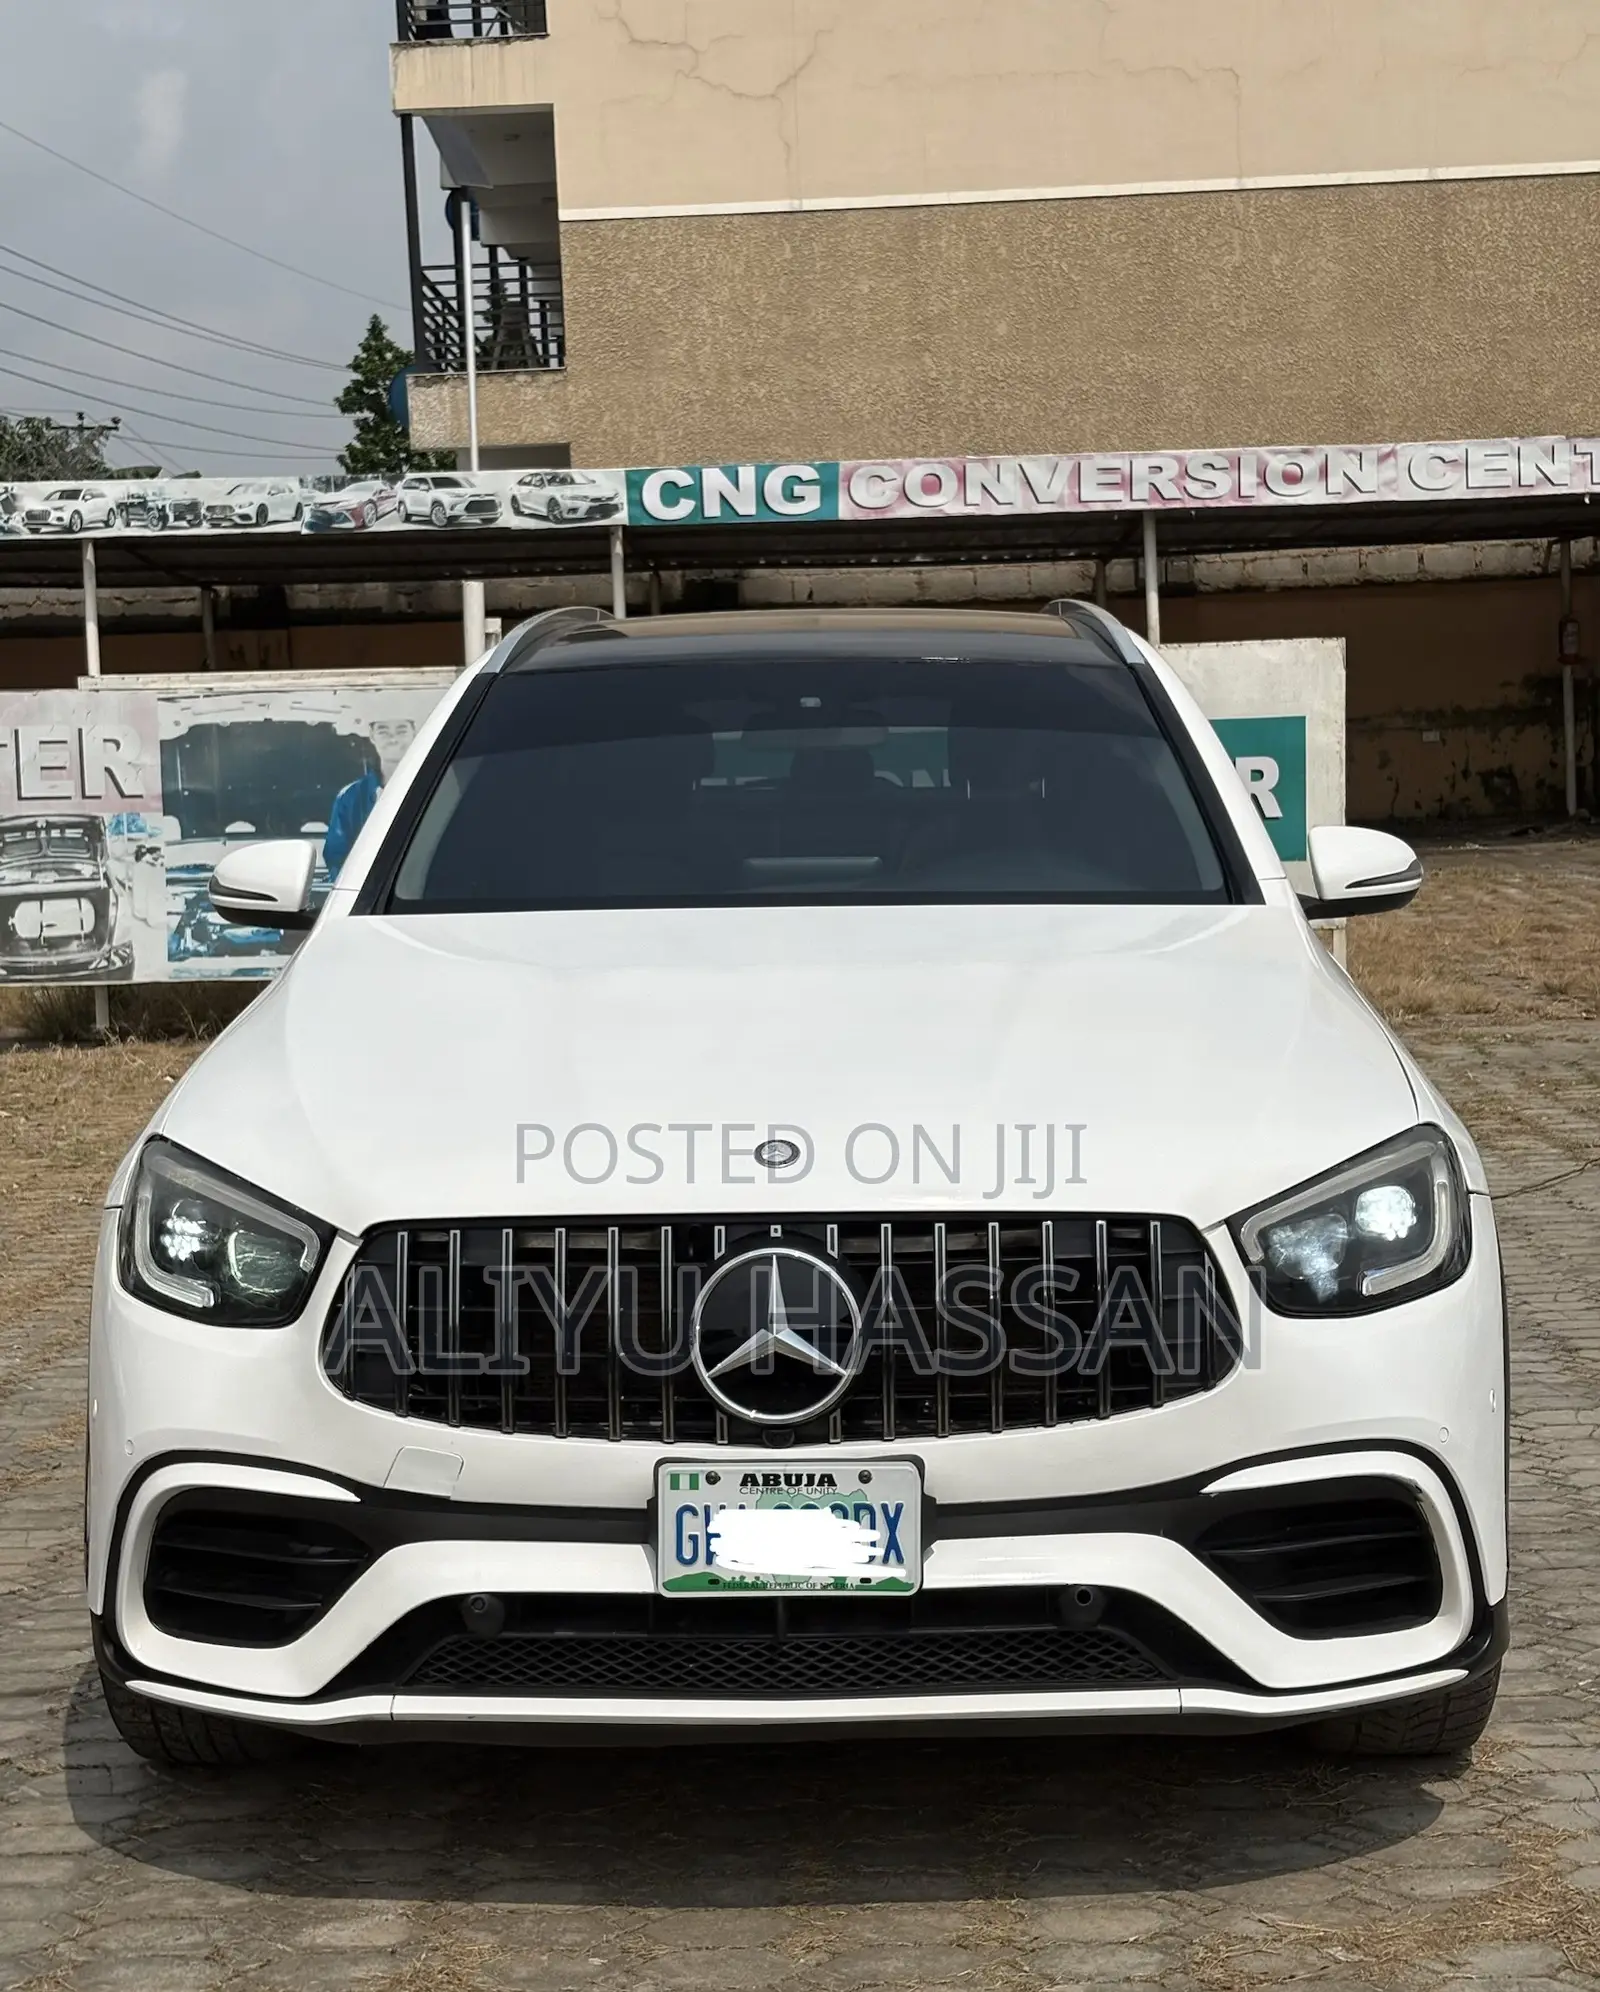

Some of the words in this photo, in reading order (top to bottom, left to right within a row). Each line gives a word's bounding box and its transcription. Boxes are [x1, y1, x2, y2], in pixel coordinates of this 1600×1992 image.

[642, 464, 822, 521] CNG
[848, 451, 1381, 510] CONVERSION
[740, 1473, 837, 1487] ABUJA
[739, 1487, 783, 1495] CENTRE
[786, 1487, 803, 1495] OF
[806, 1487, 837, 1495] UNITY
